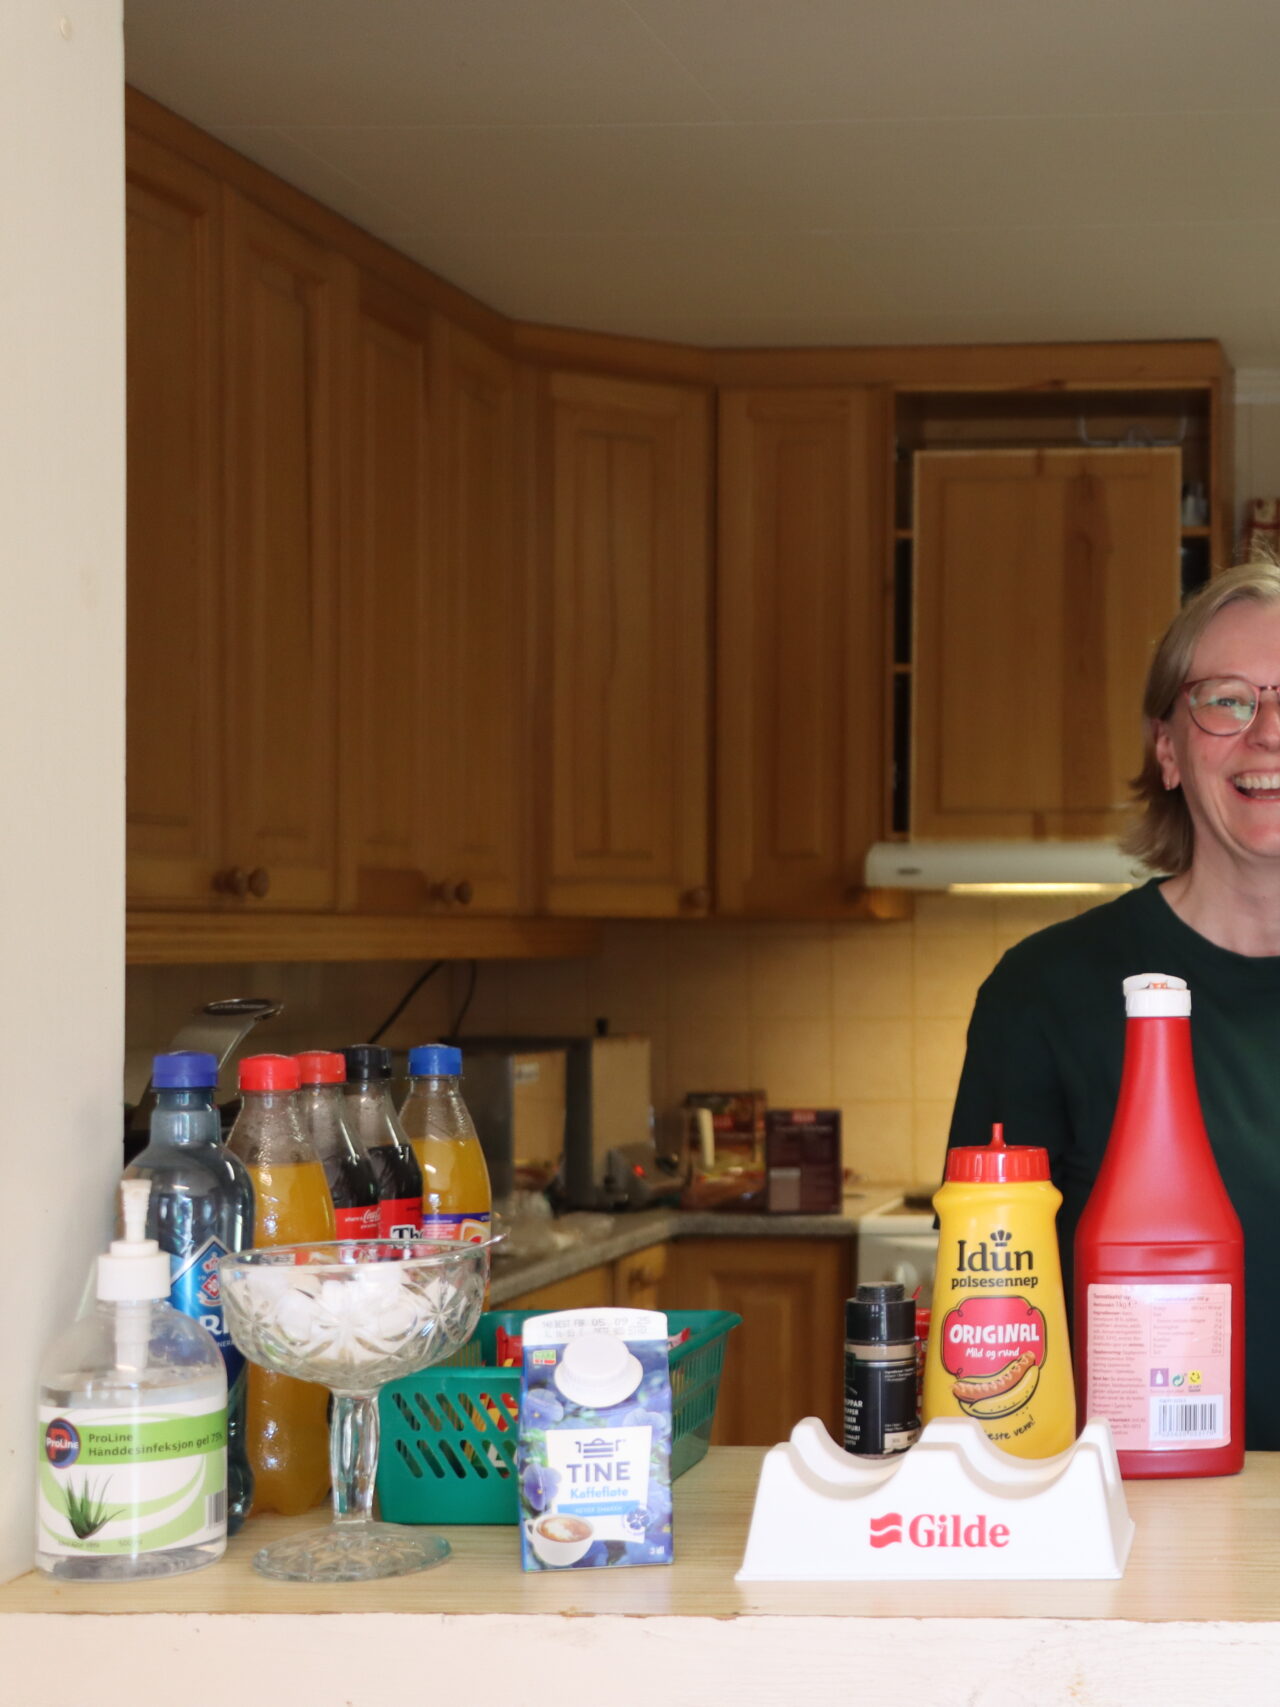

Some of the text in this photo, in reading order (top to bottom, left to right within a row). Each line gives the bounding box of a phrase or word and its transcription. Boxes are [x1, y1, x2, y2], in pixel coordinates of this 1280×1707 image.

[956, 1240, 1034, 1272] Idun
[951, 1276, 1039, 1290] pølsesennep
[949, 1322, 1040, 1344] ORIGINAL
[965, 1346, 1020, 1360] Mild og rund
[46, 1437, 80, 1450] ProLine
[88, 1433, 133, 1443] ProLine
[196, 1434, 210, 1450] gel
[566, 1461, 631, 1483] TINE
[570, 1485, 629, 1500] Kaffefløte
[908, 1513, 1011, 1548] Gilde
